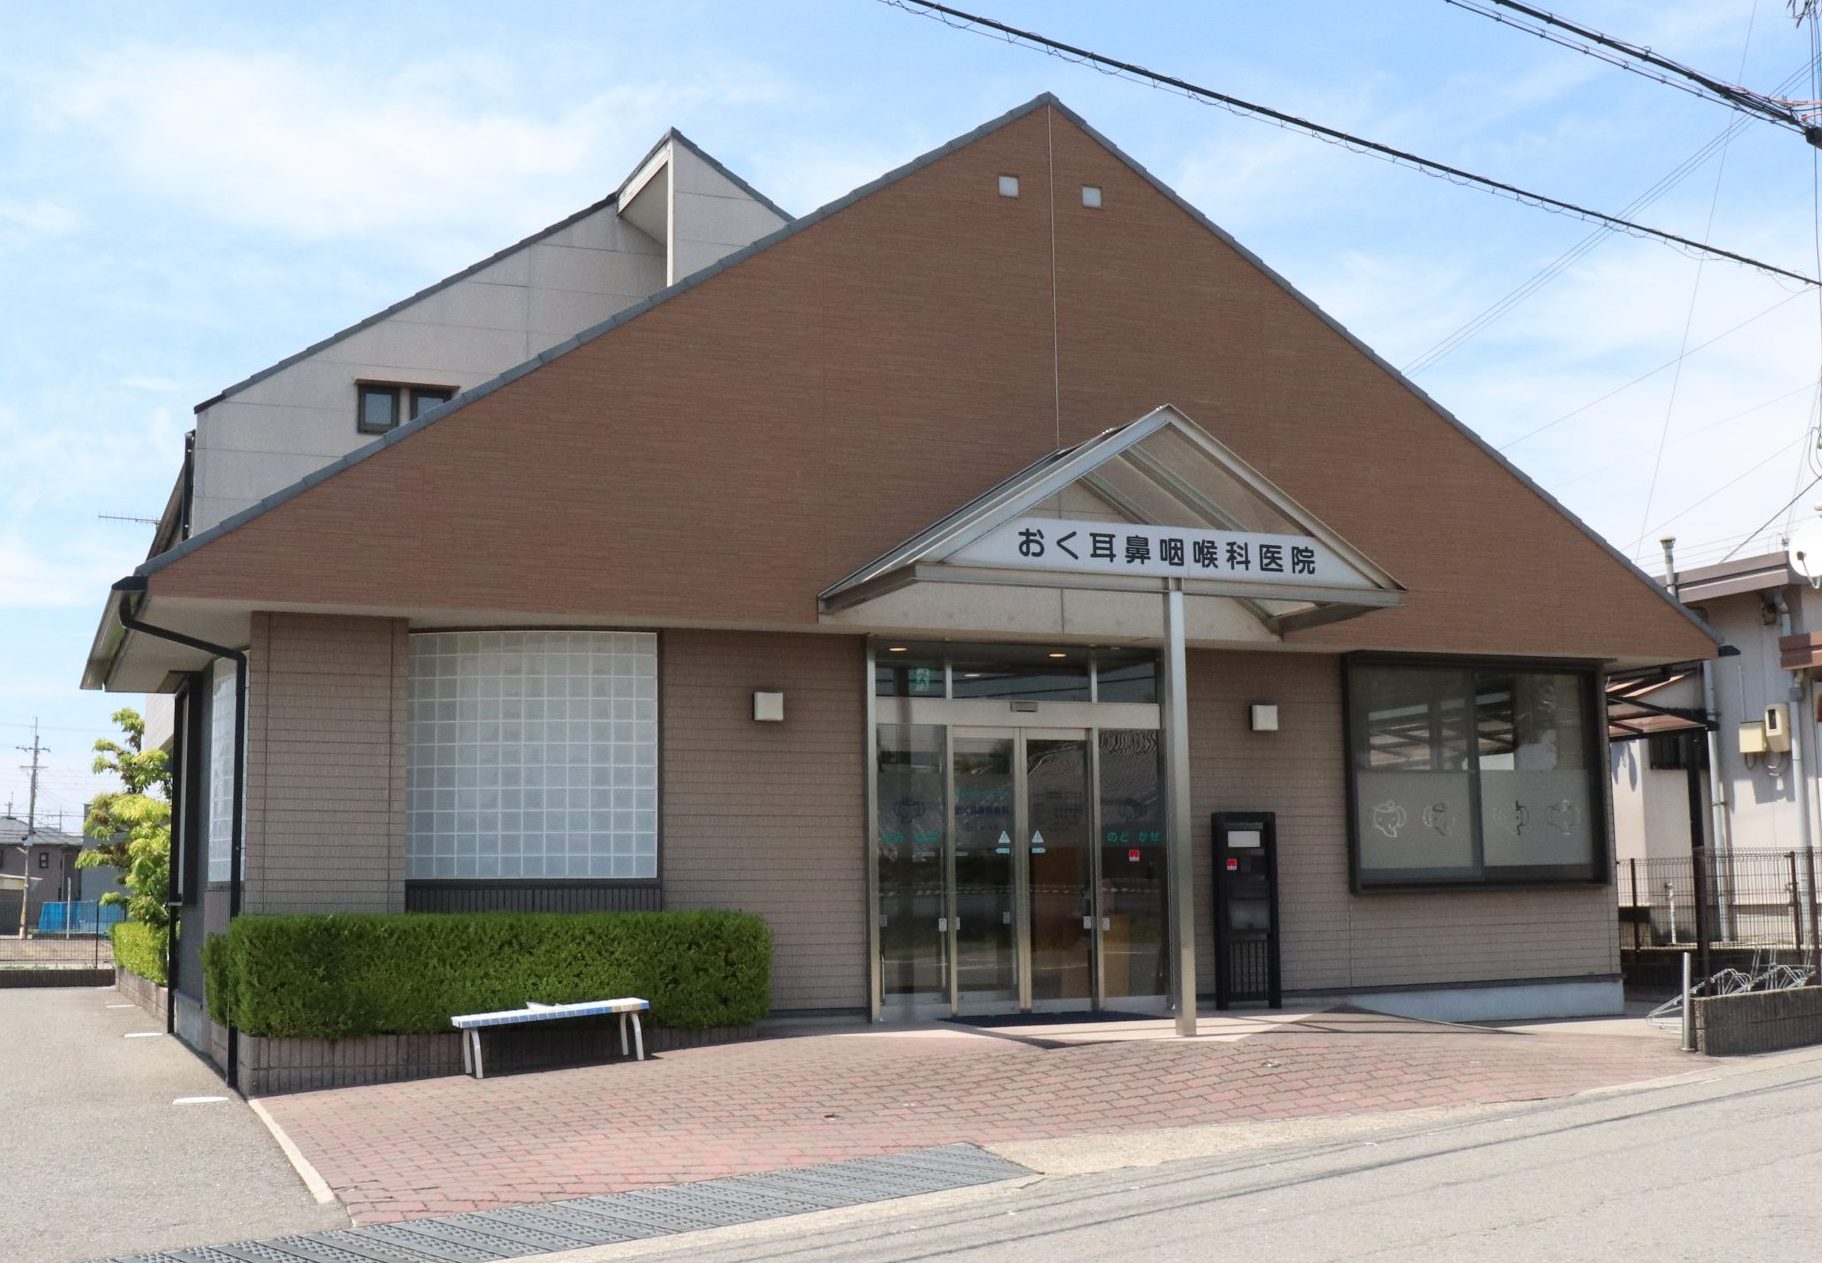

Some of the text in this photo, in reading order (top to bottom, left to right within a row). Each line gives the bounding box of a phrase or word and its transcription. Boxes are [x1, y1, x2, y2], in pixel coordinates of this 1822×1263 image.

[1018, 528, 1316, 575] おく耳鼻咽喉科医院
